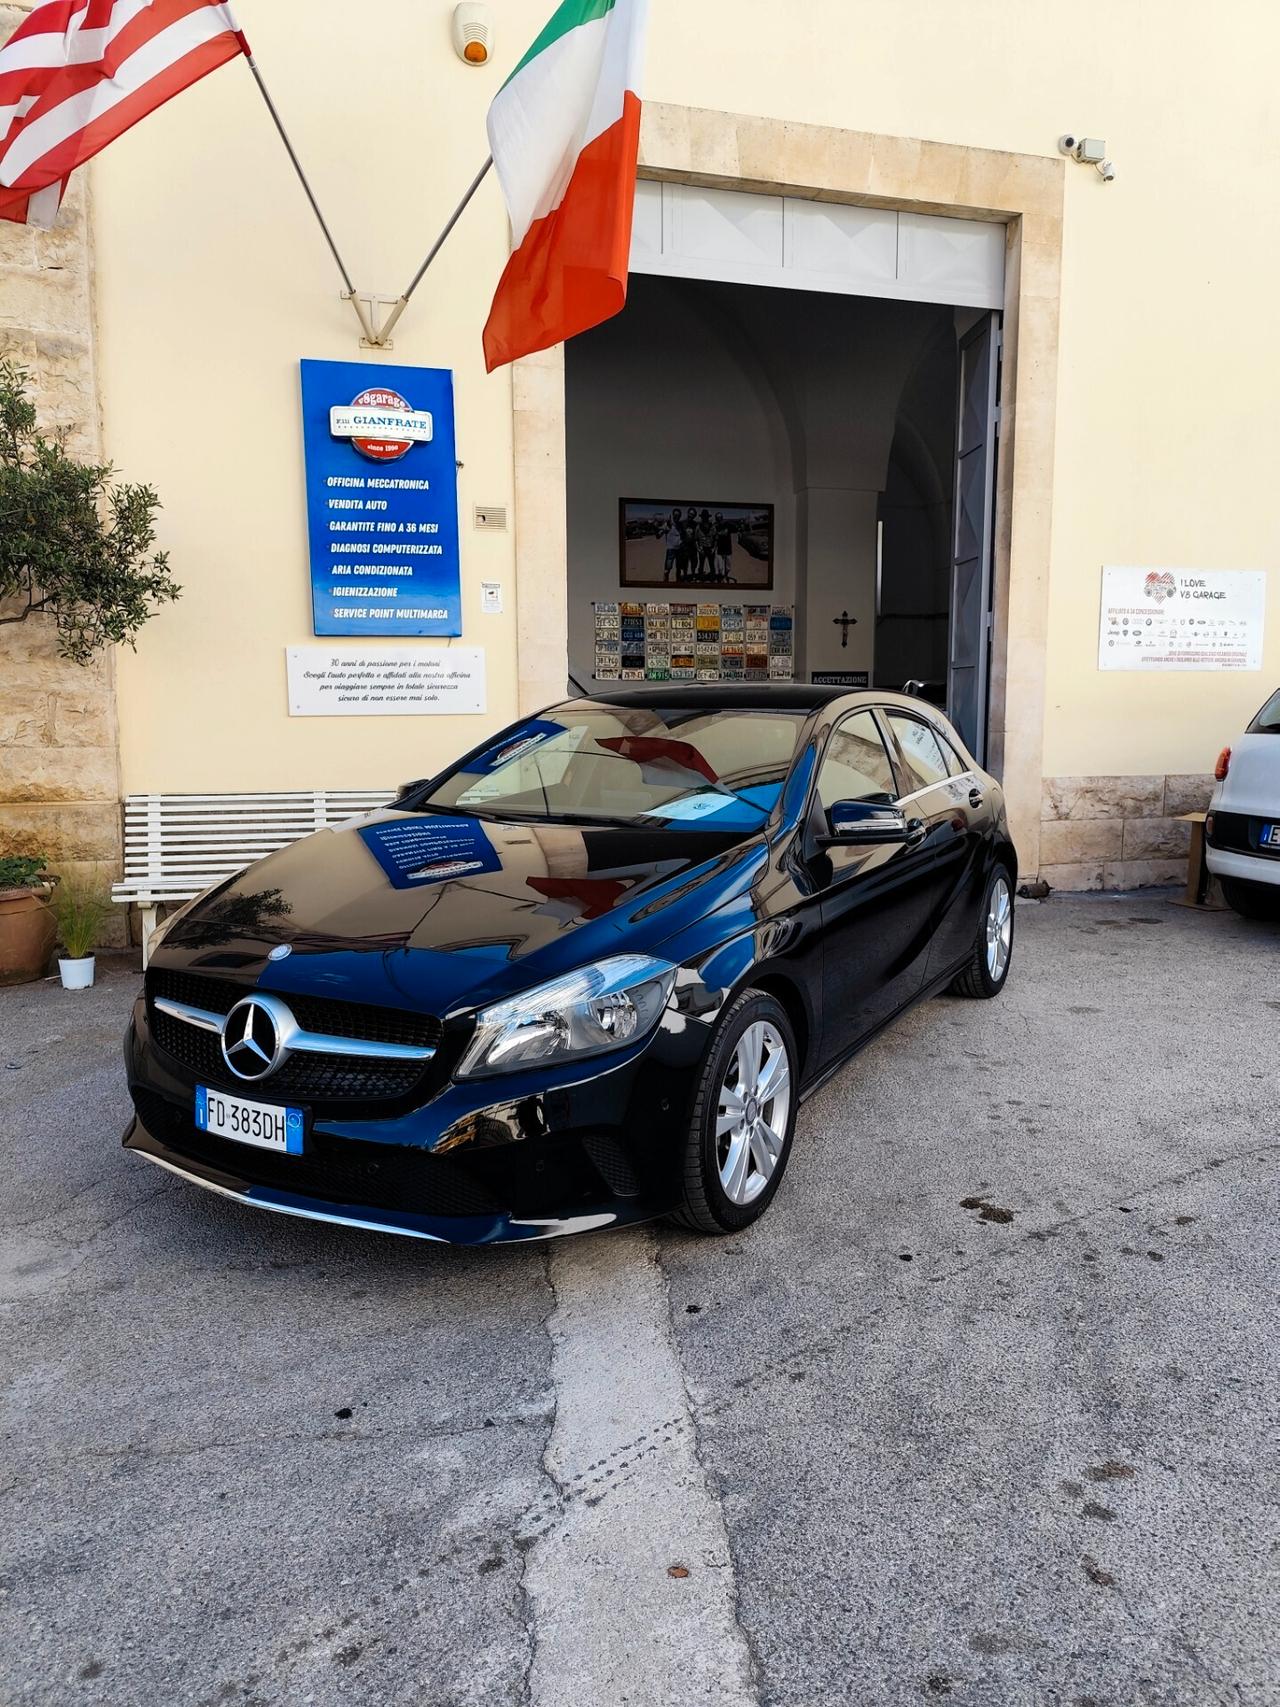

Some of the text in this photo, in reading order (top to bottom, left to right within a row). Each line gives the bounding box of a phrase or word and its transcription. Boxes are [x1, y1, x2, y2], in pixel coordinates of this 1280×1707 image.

[353, 416, 427, 429] GIANFRATE
[327, 477, 429, 490] OFFICINA MECCATRONICA
[328, 499, 387, 510] VENDITA AUTO
[329, 521, 439, 533] GARANTITE FINO A 36 MESI
[331, 543, 443, 555] DIAGNOSI COMPUTERIZZATA
[332, 565, 413, 576] ARIA CONDIZIONATA
[1184, 578, 1206, 588] LOVE
[333, 587, 398, 597] IGIENIZZAZIONE
[1180, 590, 1227, 600] V8 GARAGE
[334, 608, 448, 619] SERVICE POINT MULTIMARCA
[330, 658, 340, 667] 30
[366, 660, 398, 668] passione
[303, 671, 326, 680] Scegli
[347, 672, 375, 680] perfetta
[382, 671, 408, 680] affidati
[446, 671, 471, 680] officina
[813, 676, 867, 684] ACCETTAZIONE
[334, 683, 368, 691] viaggiare
[369, 683, 395, 691] sempre
